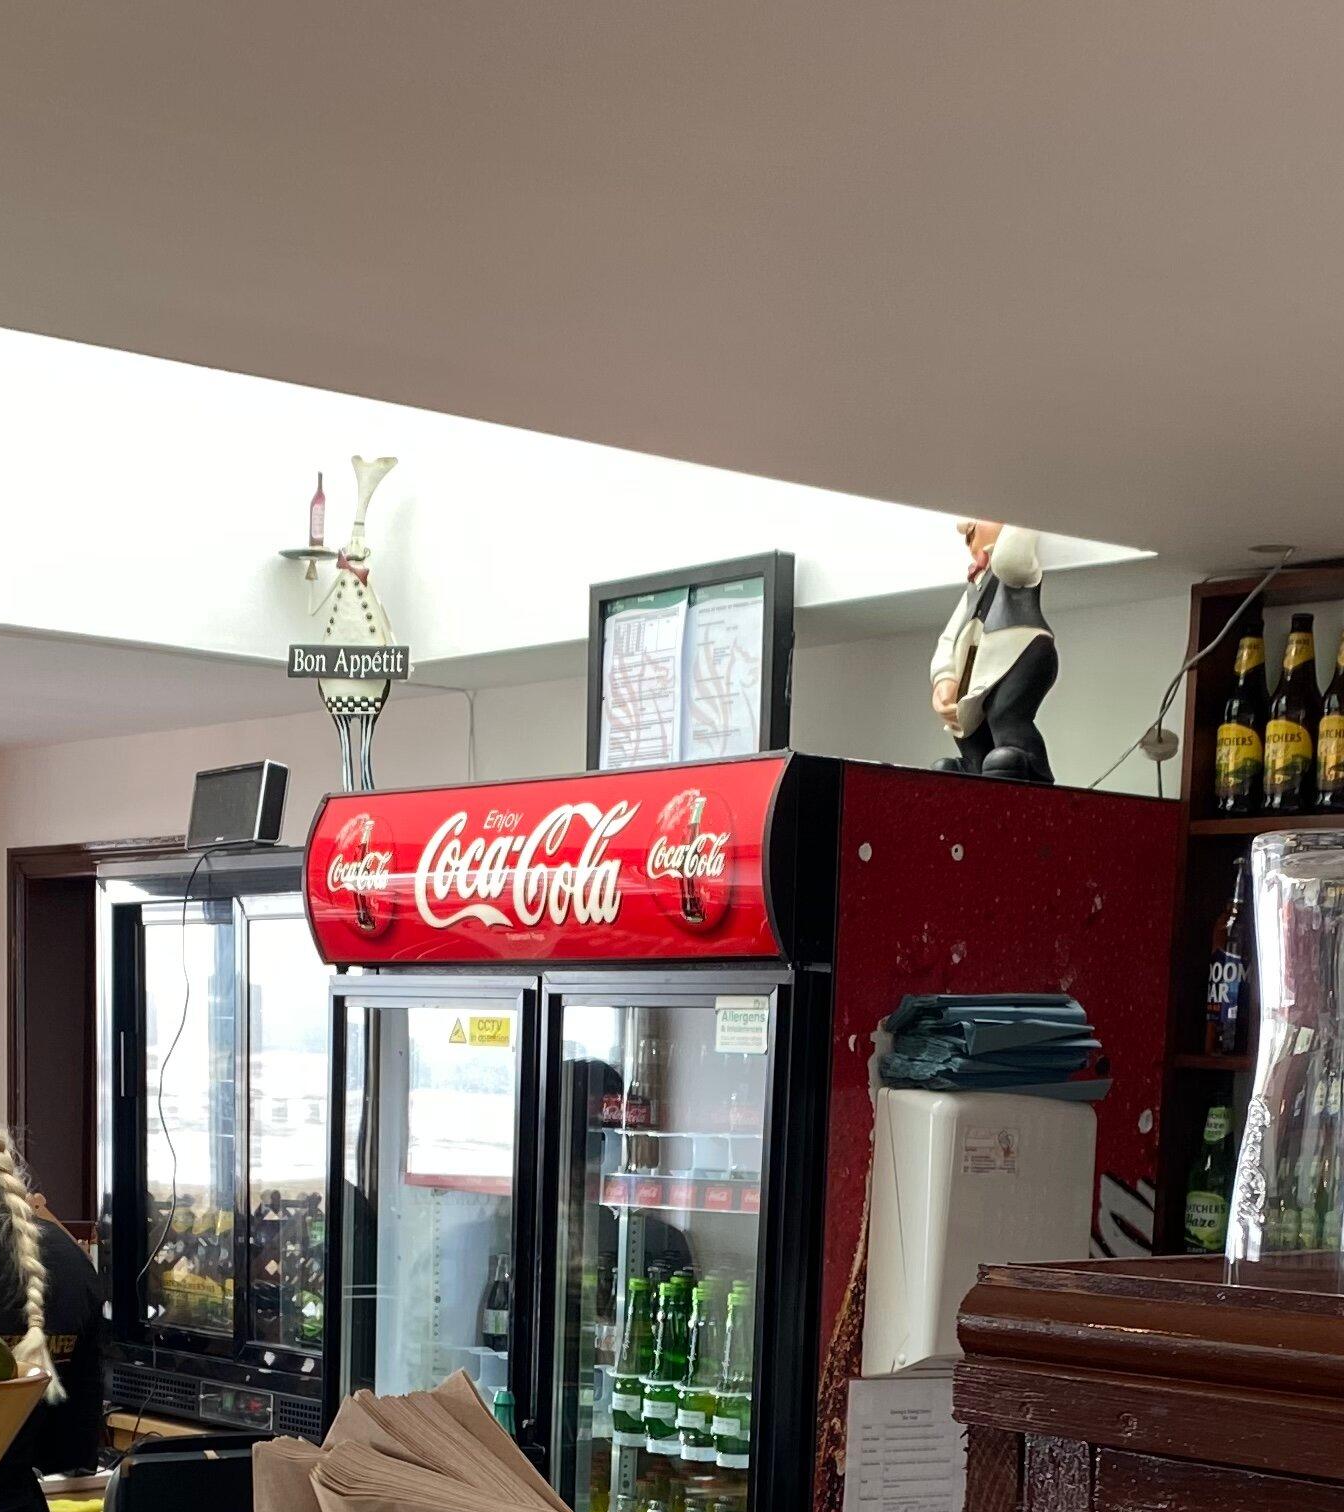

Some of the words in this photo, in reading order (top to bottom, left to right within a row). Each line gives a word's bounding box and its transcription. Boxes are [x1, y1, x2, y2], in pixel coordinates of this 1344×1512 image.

[293, 648, 327, 672] Bon
[334, 647, 404, 678] Appétit
[482, 808, 525, 831] Enjoy
[326, 849, 394, 893] Coca-Cola
[414, 800, 643, 929] Coca-Cola
[646, 832, 732, 880] Coca-Cola
[721, 1010, 766, 1025] Allergens
